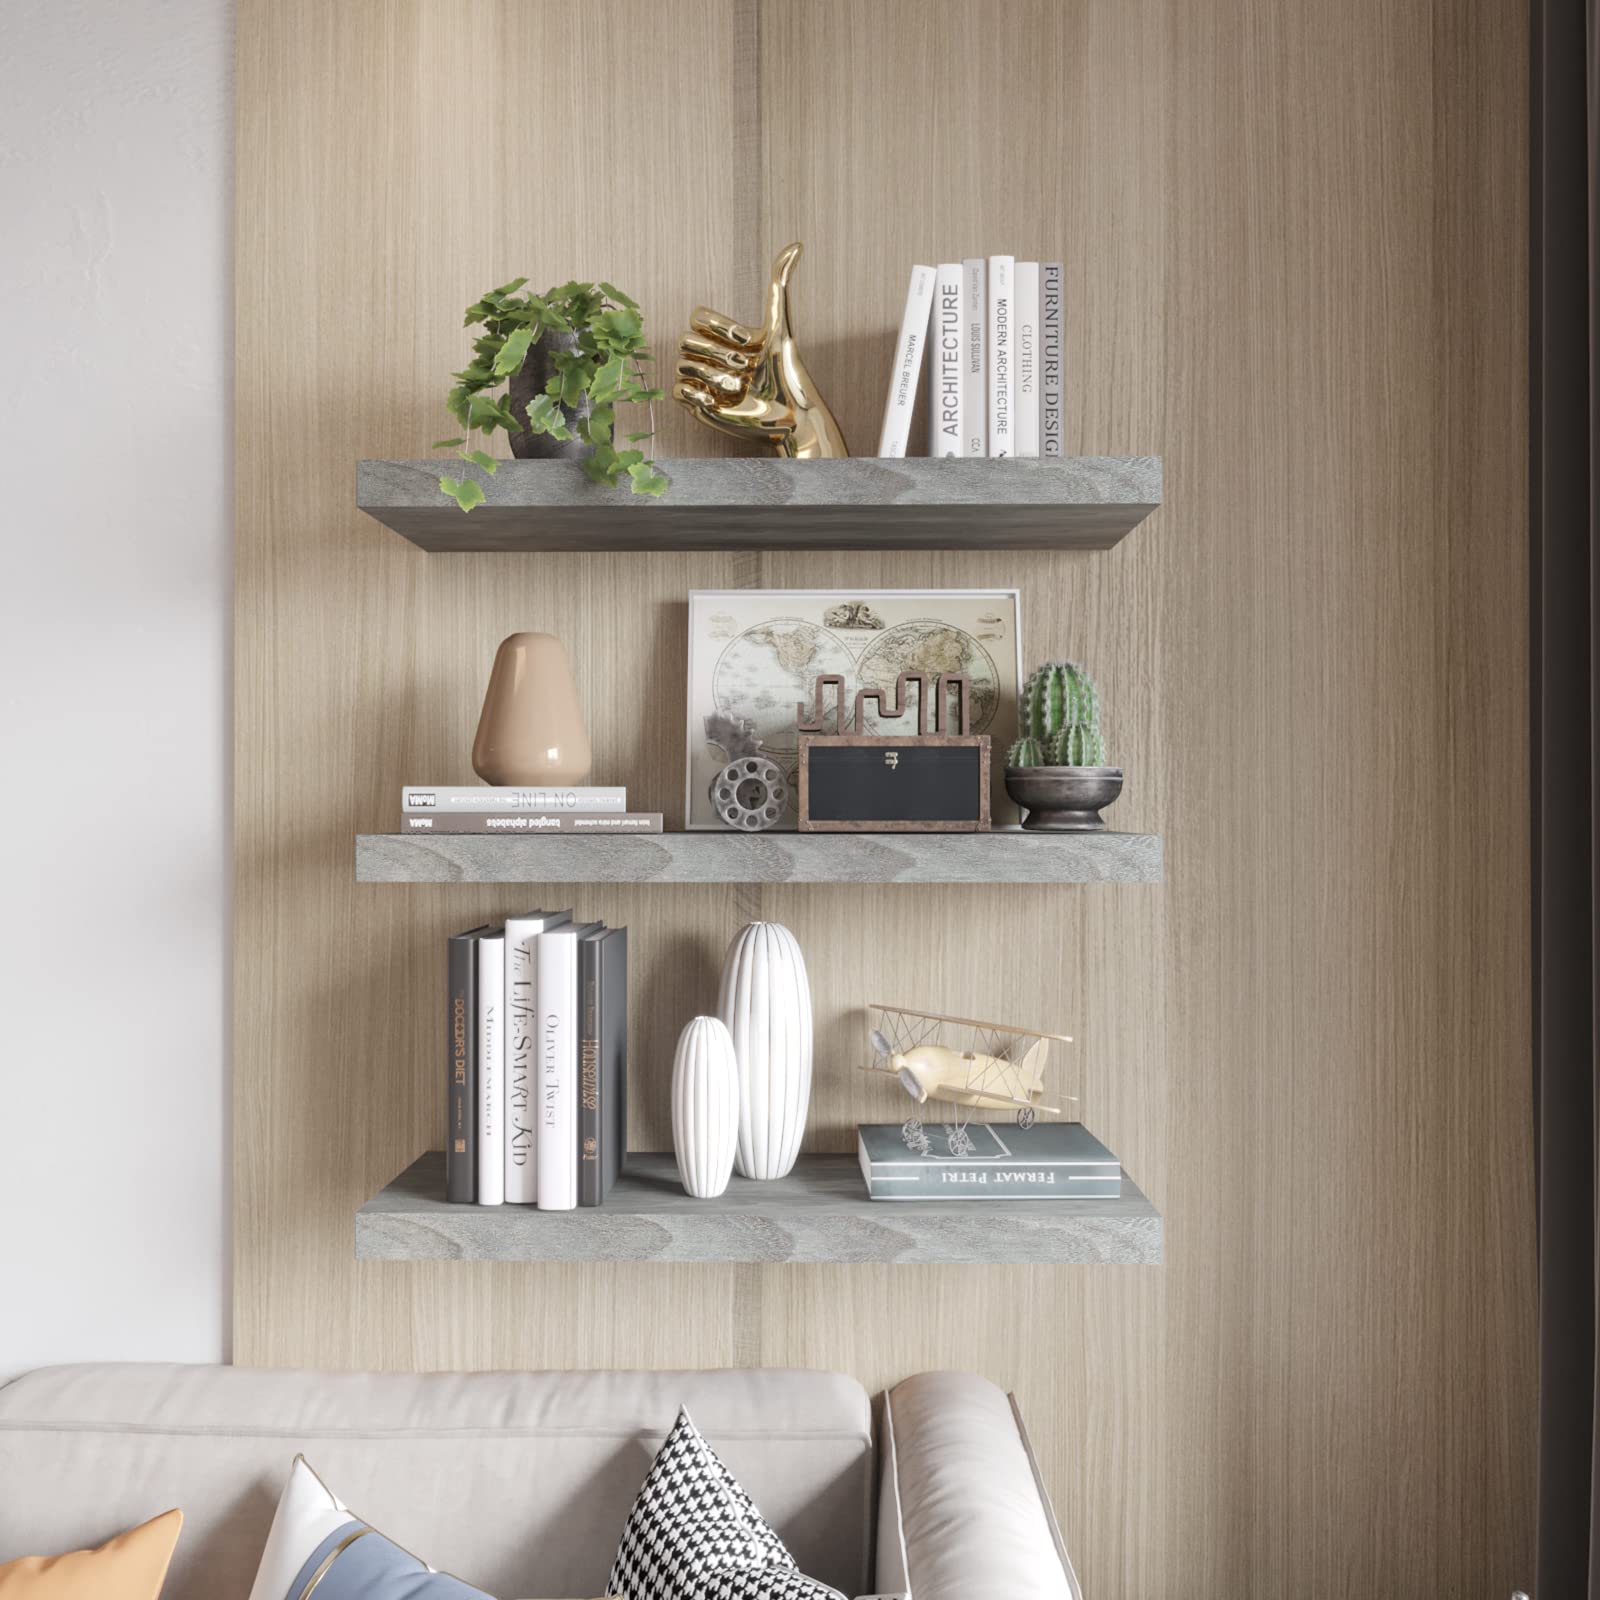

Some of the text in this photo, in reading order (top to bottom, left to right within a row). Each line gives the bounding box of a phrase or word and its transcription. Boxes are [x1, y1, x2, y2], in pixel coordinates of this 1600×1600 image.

[996, 298, 1007, 346] MODERN
[898, 334, 917, 406] MARCEL BREUER
[942, 284, 958, 437] ARCHITECTURE
[970, 323, 981, 373] LOUIS SULLIVAN
[1021, 324, 1032, 393] CLOTHING
[1045, 266, 1059, 457] FURNITURE DESIG
[996, 349, 1007, 435] ARCHITECTURE
[971, 438, 980, 453] CCA
[408, 794, 435, 806] MoMA
[409, 818, 432, 828] MoMA
[486, 816, 561, 828] tangled alphabets
[511, 792, 576, 808] ON LINE
[454, 1059, 466, 1086] DIET
[486, 1005, 495, 1137] MIDDLEMARCH
[941, 1172, 1056, 1184] FERMAT PETRI
